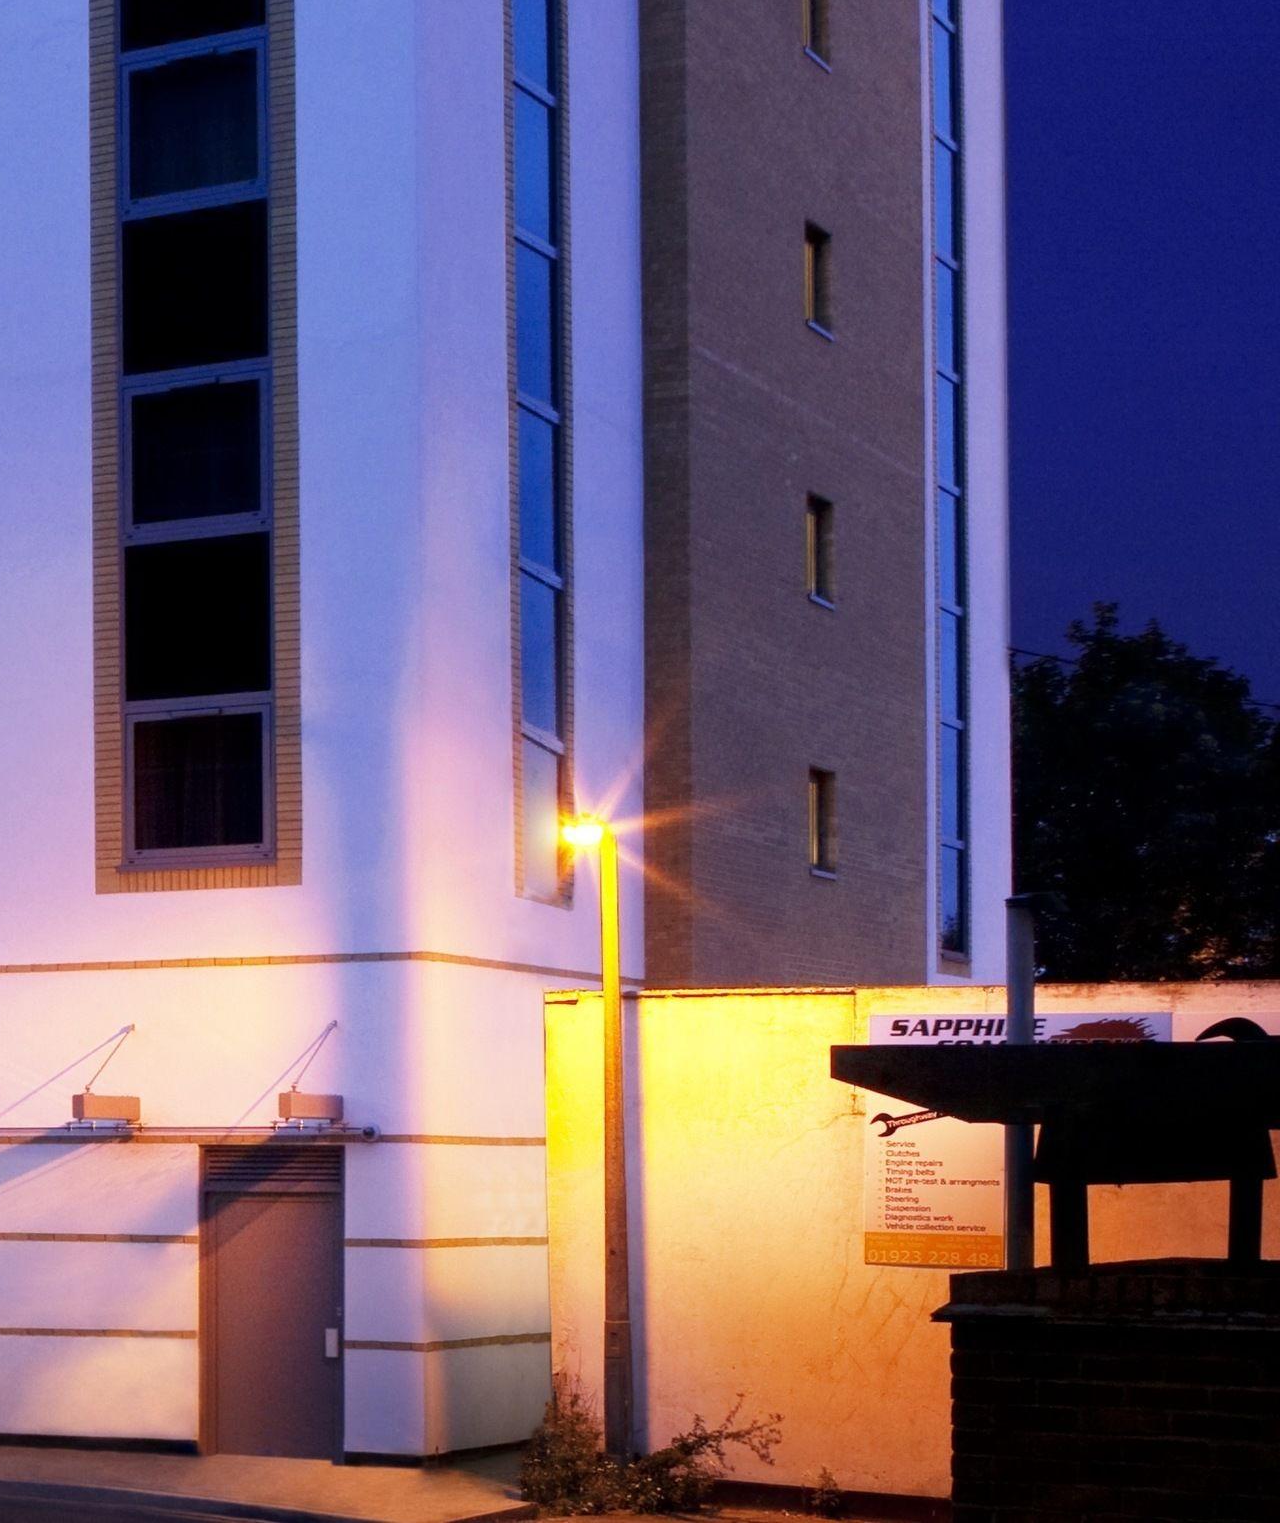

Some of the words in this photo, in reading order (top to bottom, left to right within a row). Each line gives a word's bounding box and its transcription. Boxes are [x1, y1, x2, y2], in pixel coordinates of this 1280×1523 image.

[890, 1017, 1047, 1037] SAPPHIE
[885, 1140, 916, 1148] Service
[885, 1149, 920, 1157] Clutches
[885, 1159, 912, 1167] Engine
[915, 1160, 943, 1168] repairs
[886, 1168, 913, 1176] Timing
[915, 1168, 935, 1176] belts
[906, 1178, 937, 1186] pre-test
[885, 1186, 912, 1194] Brakes
[885, 1195, 919, 1204] Steering
[885, 1204, 931, 1213] Suspension
[885, 1214, 931, 1222] Diagnostics
[886, 1223, 914, 1231] Vehicle
[915, 1223, 954, 1232] collection
[956, 1224, 986, 1232] service
[868, 1249, 922, 1263] 01923
[928, 1251, 961, 1265] 228
[967, 1252, 1001, 1267] 484
